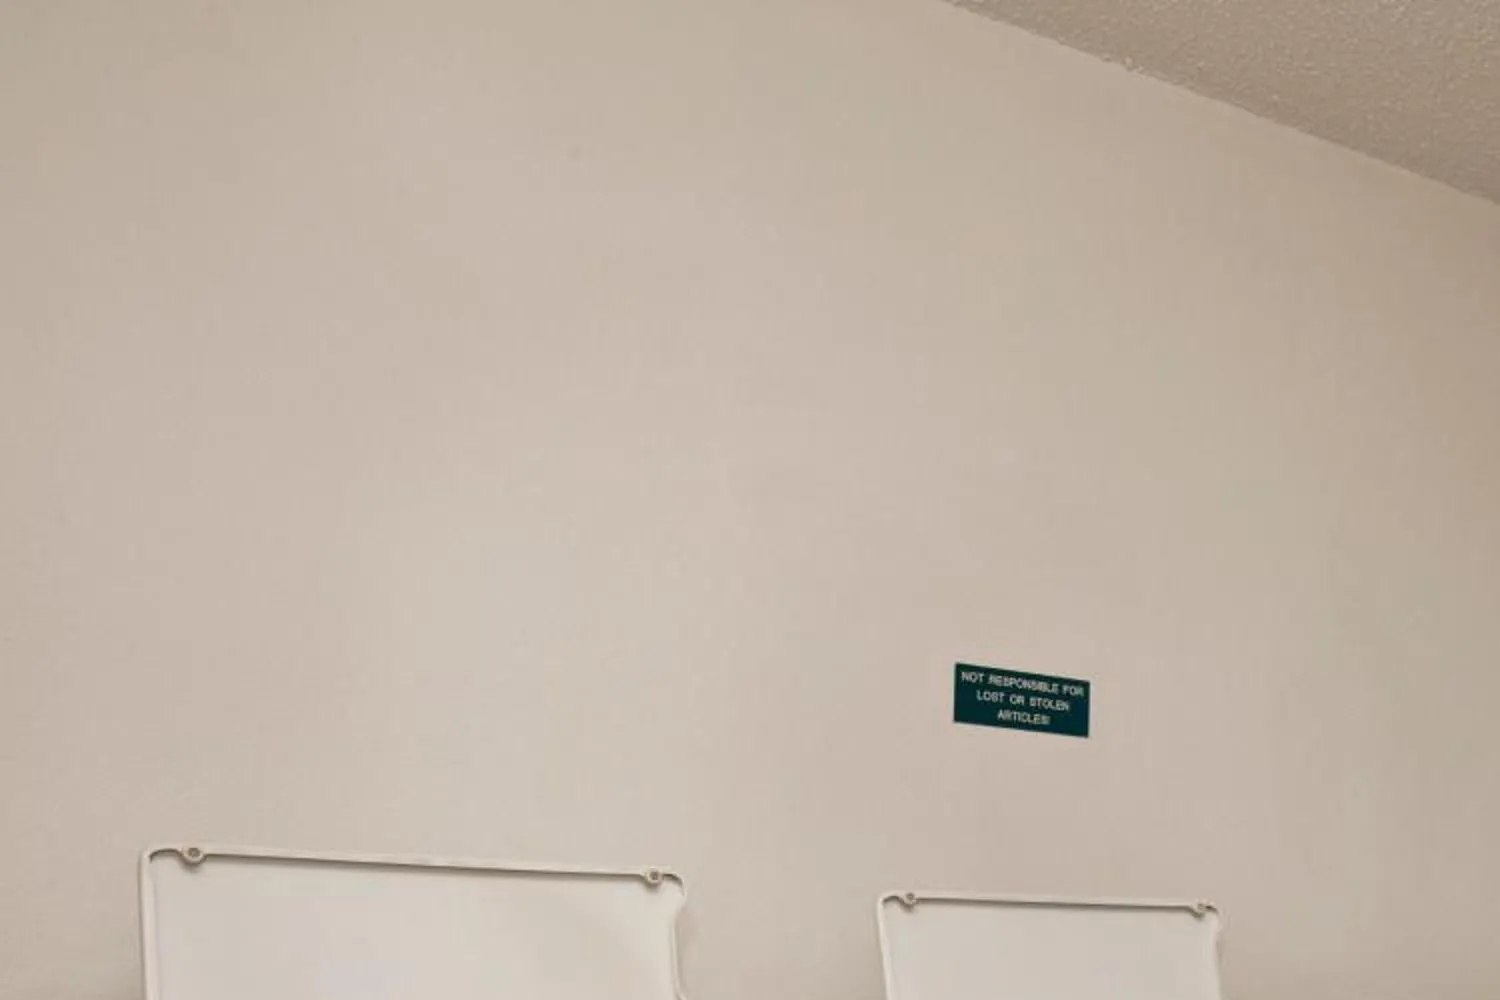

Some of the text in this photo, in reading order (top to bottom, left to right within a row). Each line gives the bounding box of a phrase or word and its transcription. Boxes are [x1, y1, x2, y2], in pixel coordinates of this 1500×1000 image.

[961, 671, 1084, 697] NOT RESPONSIBLE FOR
[976, 690, 1070, 711] LOST OR STOLEN
